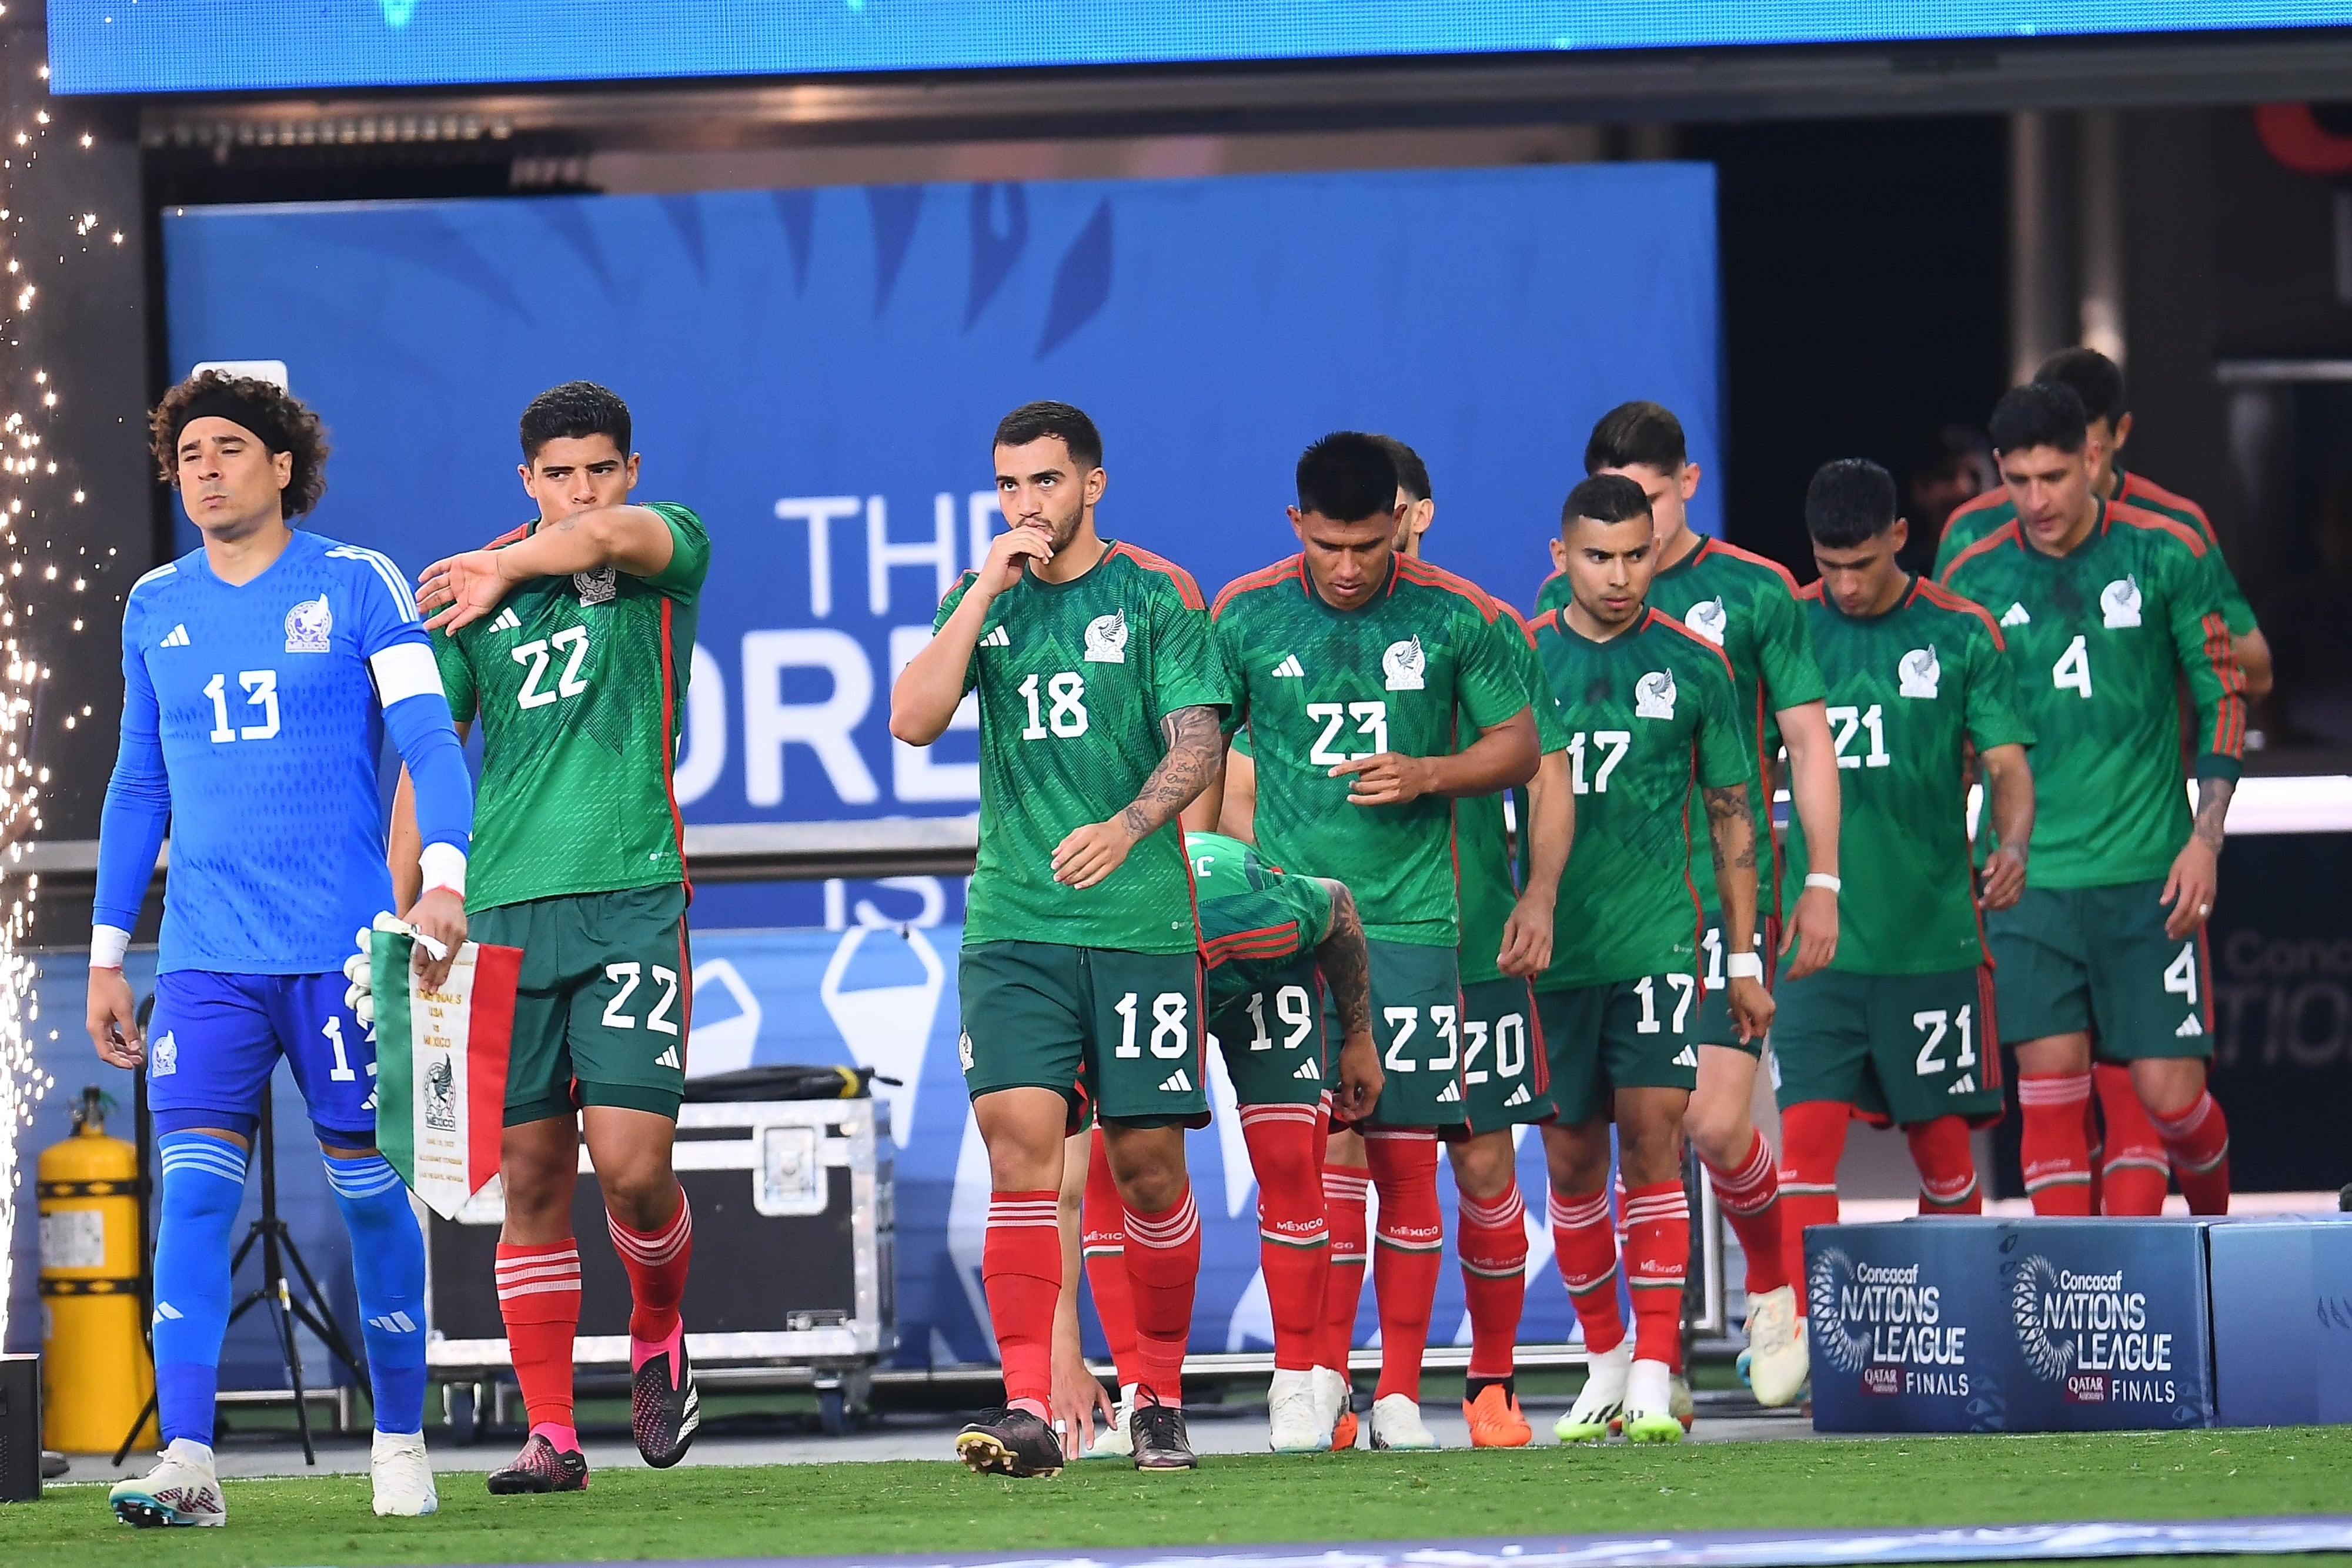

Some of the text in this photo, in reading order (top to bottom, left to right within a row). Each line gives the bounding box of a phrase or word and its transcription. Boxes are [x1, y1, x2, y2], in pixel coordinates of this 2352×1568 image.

[511, 624, 590, 710] 22
[2053, 635, 2092, 698] 4
[203, 670, 281, 743] 13
[1017, 671, 1089, 740] 18
[1307, 701, 1387, 765] 23
[1825, 704, 1890, 768] 21
[1566, 731, 1631, 794] 17
[601, 962, 678, 1036] 22
[1633, 973, 1695, 1034] 17
[2164, 942, 2197, 1004] 4
[1114, 992, 1188, 1059] 18
[1245, 985, 1312, 1051] 19
[1384, 1005, 1458, 1072] 23
[1464, 1013, 1525, 1085] 20
[1913, 1004, 1976, 1075] 21
[1083, 1230, 1125, 1243] MÉXIC
[1276, 1217, 1323, 1231] MÉXICO
[1856, 1262, 1919, 1284] Concacaf
[2060, 1269, 2123, 1291] Concacaf
[1840, 1285, 1940, 1325] NATIONS
[2043, 1292, 2146, 1331] NATIONS
[1873, 1325, 1966, 1365] LEAGUE
[2077, 1332, 2172, 1372] LEAGUE
[1864, 1368, 1897, 1386] QATAR
[1905, 1371, 1969, 1397] FINALS
[2067, 1376, 2104, 1395] QATAR
[2112, 1379, 2176, 1403] FINALS
